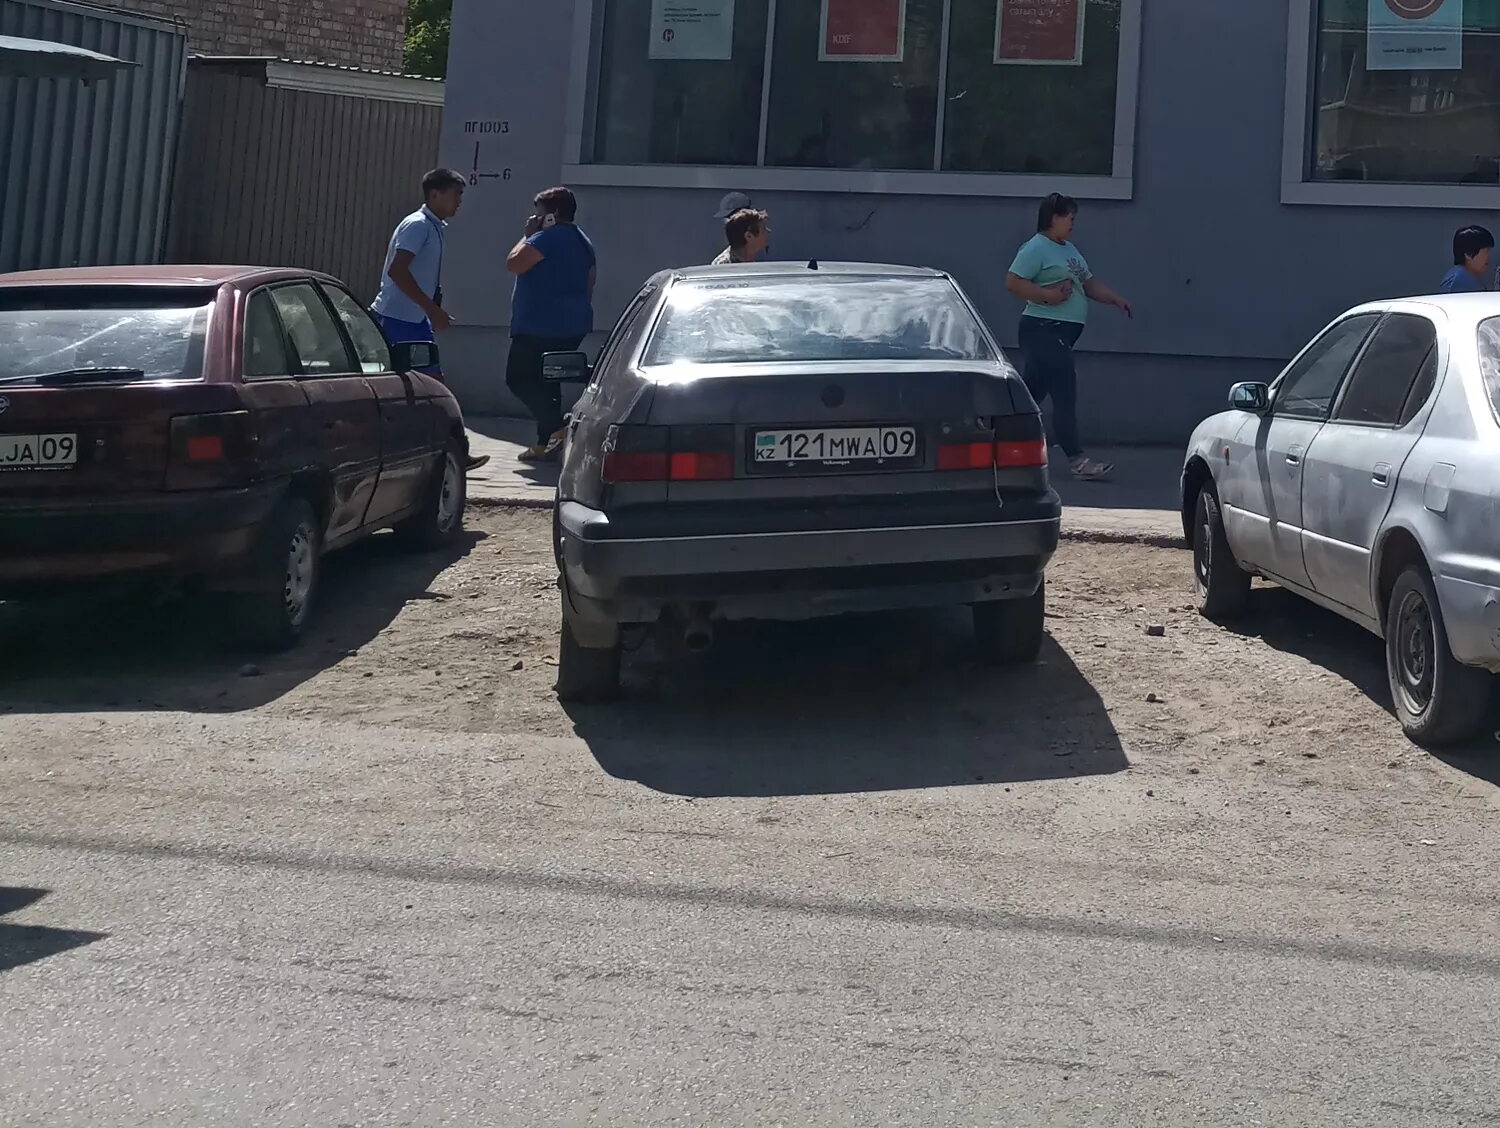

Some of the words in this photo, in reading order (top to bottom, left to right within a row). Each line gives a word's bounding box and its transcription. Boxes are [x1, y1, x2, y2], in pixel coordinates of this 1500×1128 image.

[0, 443, 34, 462] JA
[42, 436, 74, 460] 09
[755, 449, 776, 459] KZ
